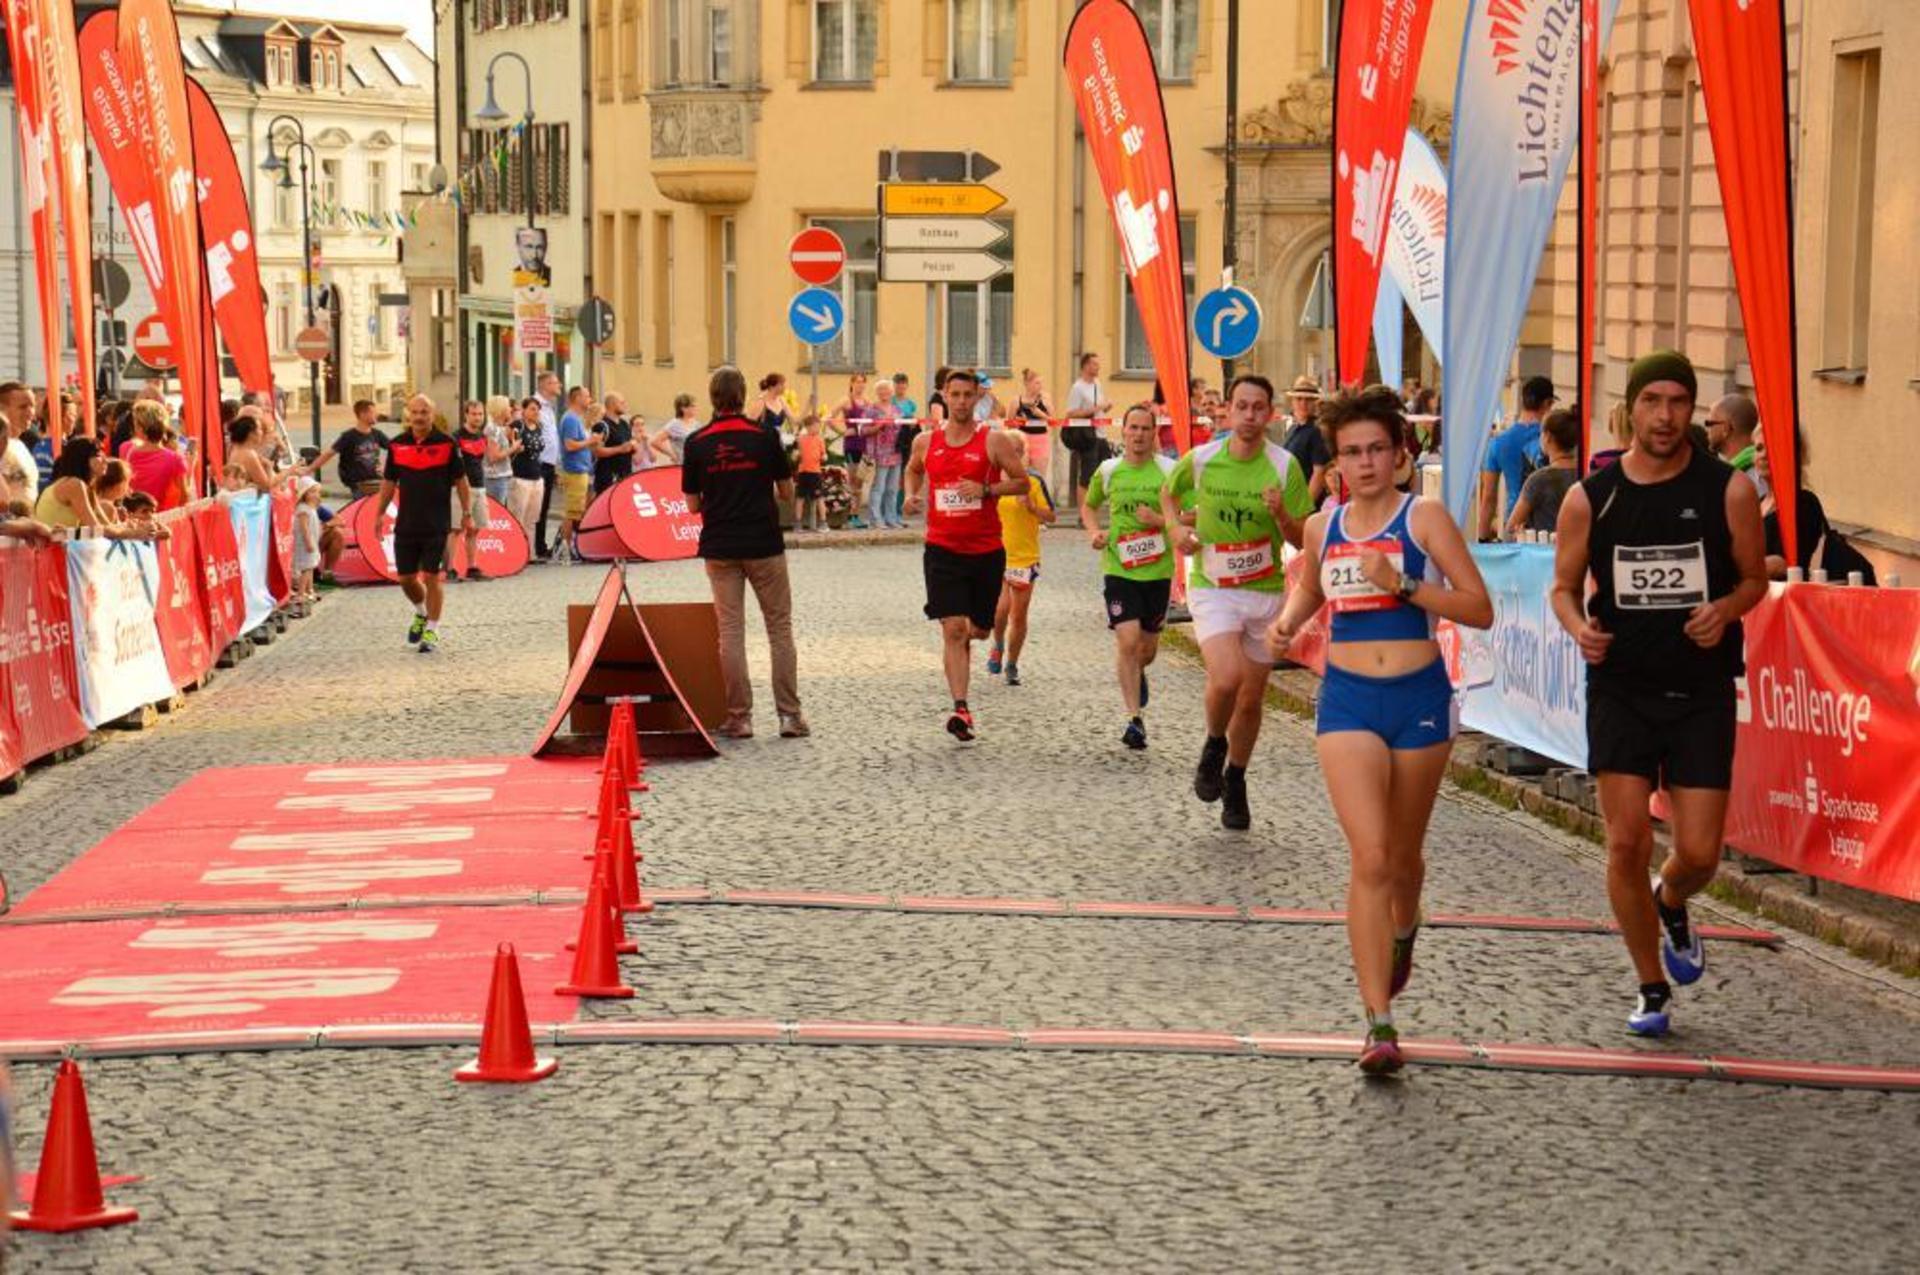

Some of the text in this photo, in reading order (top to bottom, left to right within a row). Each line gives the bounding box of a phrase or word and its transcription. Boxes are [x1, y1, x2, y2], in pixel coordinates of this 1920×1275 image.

[1517, 0, 1577, 184] Lichtena
[919, 227, 960, 239] Rathaus
[1330, 567, 1368, 587] 213
[1631, 567, 1686, 590] 522
[1759, 664, 1872, 757] Challenge
[1820, 789, 1880, 824] Sparkasse
[1828, 829, 1866, 870] Leipzig
